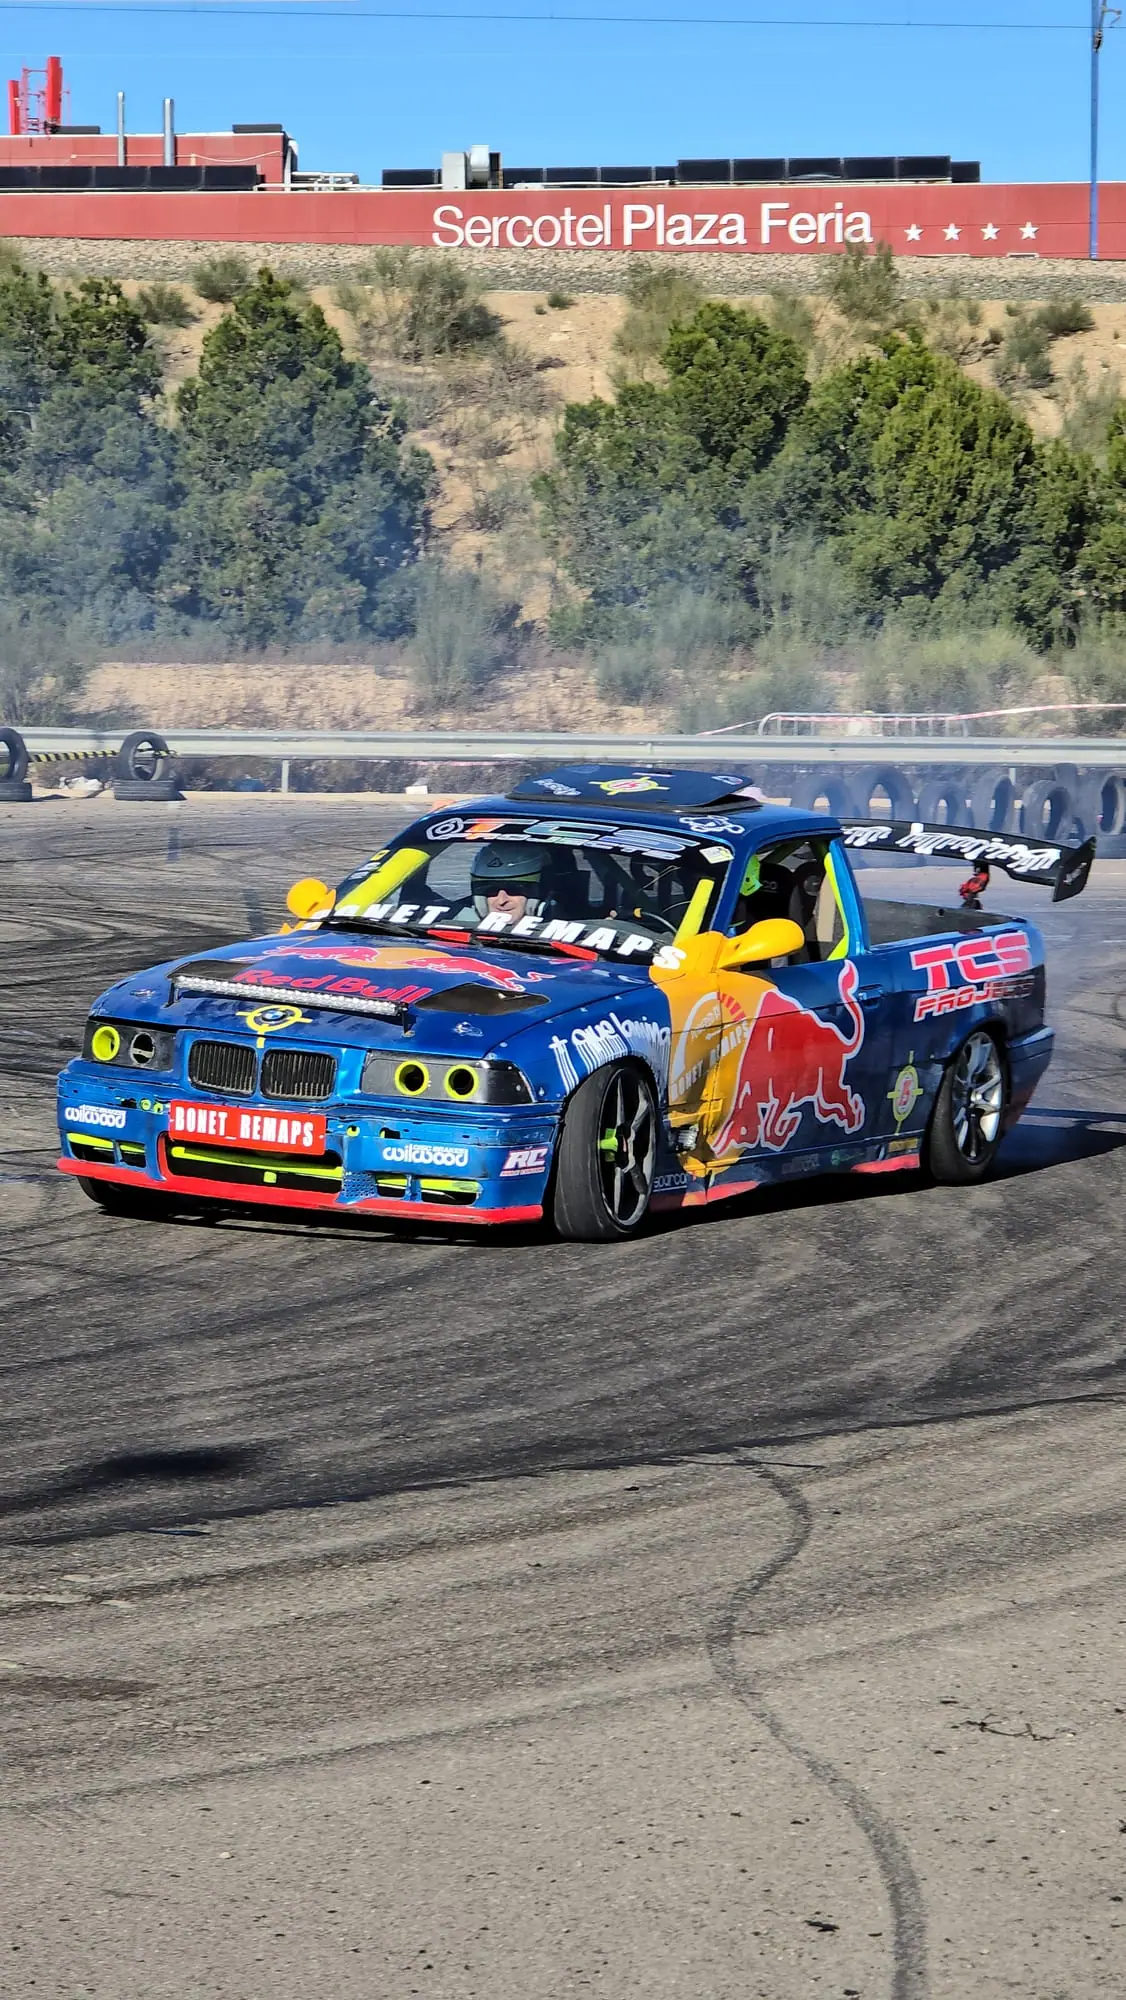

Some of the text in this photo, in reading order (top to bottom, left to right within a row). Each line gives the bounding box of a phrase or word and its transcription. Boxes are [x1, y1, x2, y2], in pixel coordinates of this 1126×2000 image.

[432, 202, 873, 247] Sercotel Plaza Feria
[464, 818, 700, 852] TCS
[909, 930, 1032, 995] TCS
[232, 969, 431, 1003] Red Bull
[65, 1104, 127, 1129] wilwood
[382, 1144, 469, 1167] wilwood
[503, 1148, 548, 1170] RC
